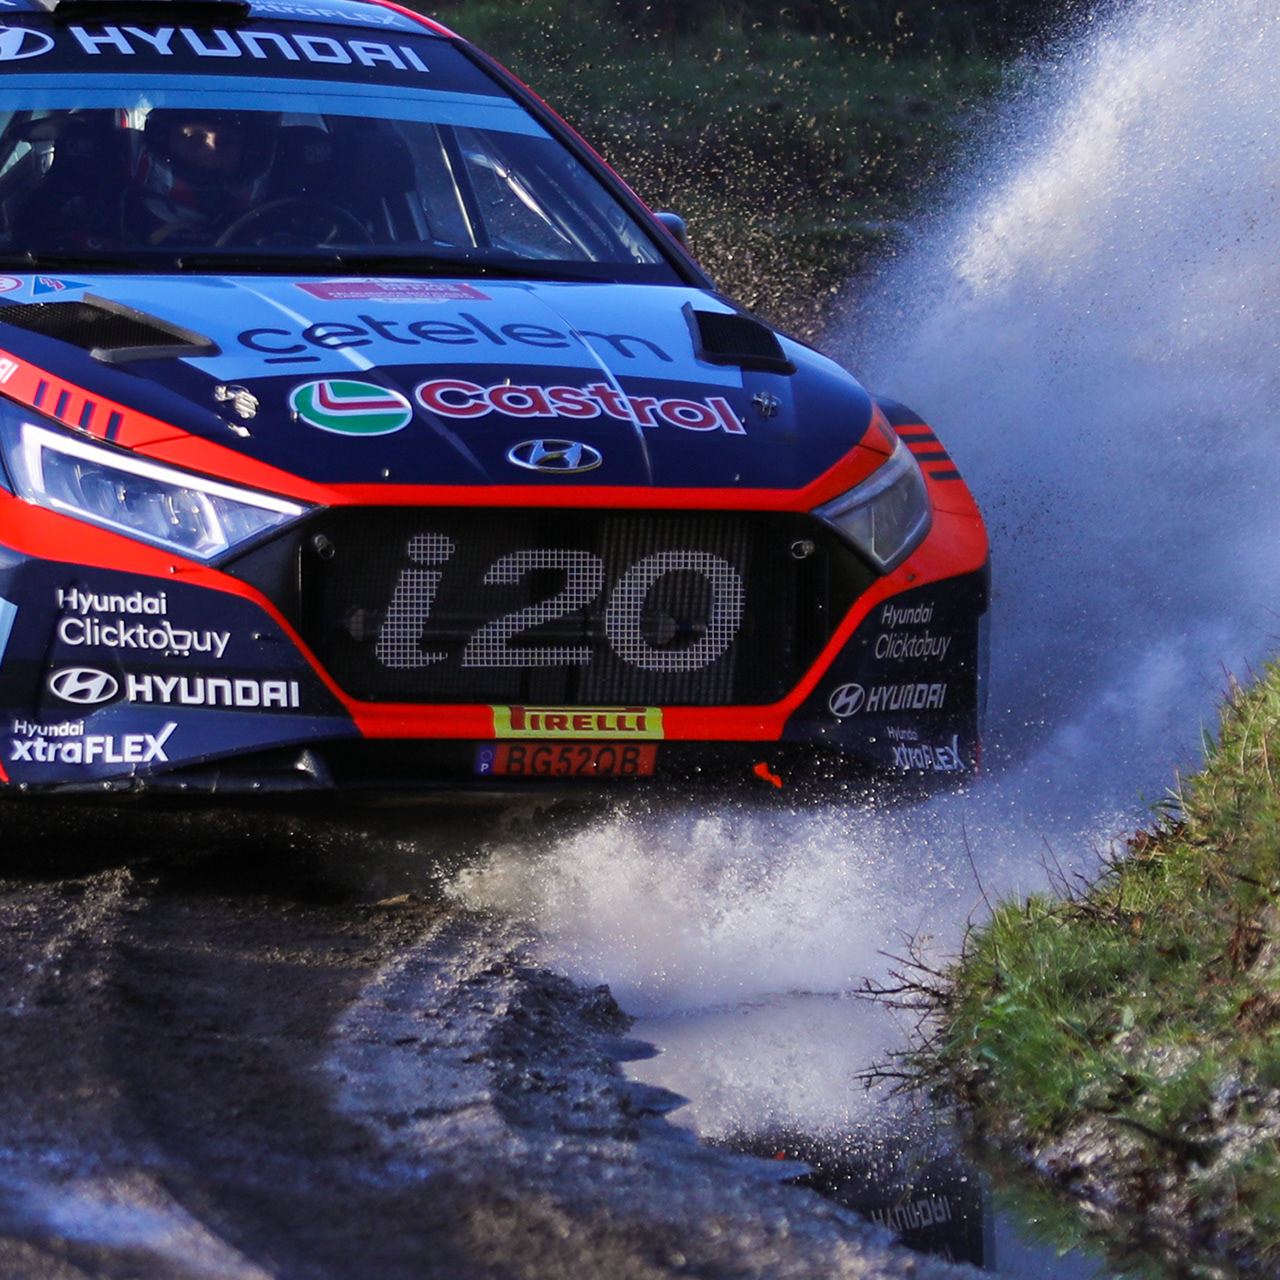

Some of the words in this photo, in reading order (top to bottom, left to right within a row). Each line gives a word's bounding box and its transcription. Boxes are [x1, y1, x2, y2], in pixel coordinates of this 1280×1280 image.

[68, 25, 429, 73] HYUNDAI
[415, 378, 748, 435] Castrol
[58, 588, 167, 618] Hyundai
[375, 533, 746, 672] i20
[881, 602, 935, 629] Hyundai
[875, 630, 952, 661] Clicktobuy
[126, 674, 300, 708] HYUNDAI
[866, 683, 947, 712] HYUNDAI
[13, 720, 85, 738] Hyundai
[509, 706, 647, 732] PIRELLI
[10, 722, 178, 764] xtraFLEX
[892, 734, 969, 771] xtraFLEX
[506, 746, 641, 776] BG52QB
